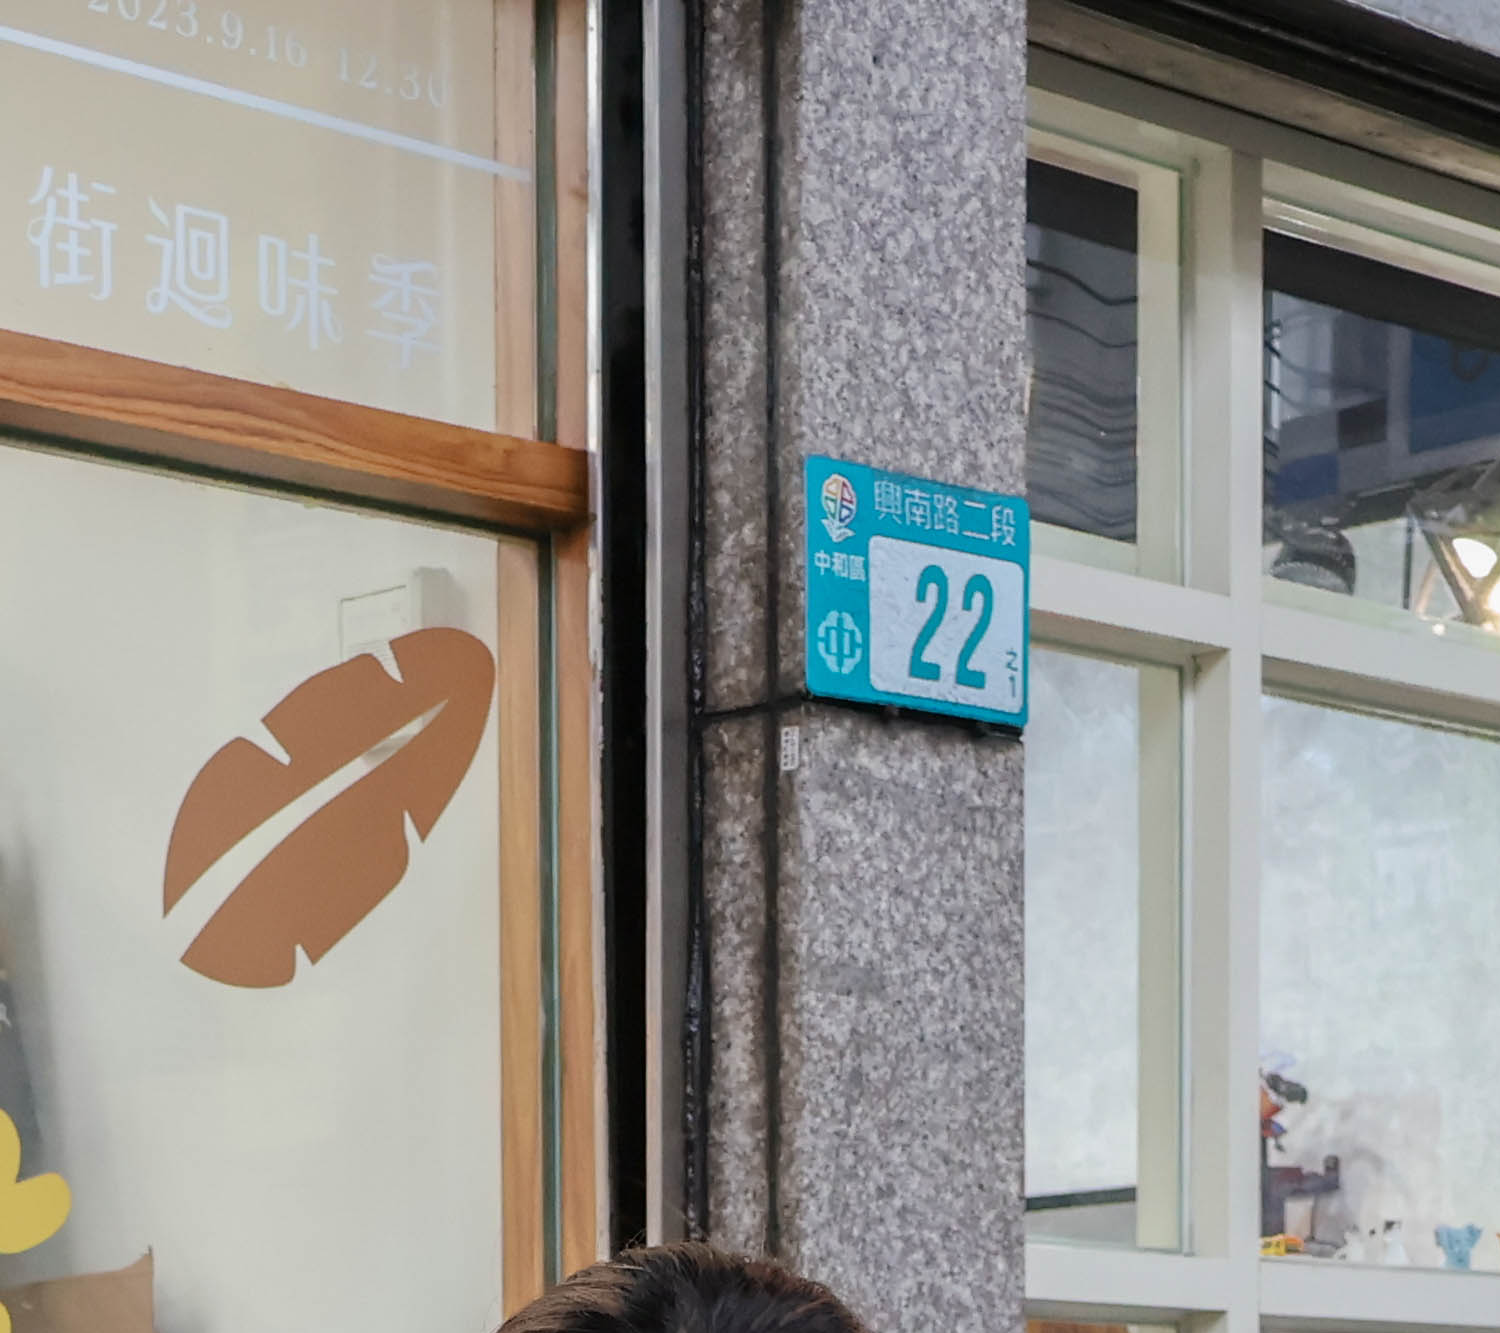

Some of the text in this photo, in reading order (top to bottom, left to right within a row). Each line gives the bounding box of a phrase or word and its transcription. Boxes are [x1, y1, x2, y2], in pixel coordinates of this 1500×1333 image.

[873, 479, 1016, 546] 興南路二段
[813, 550, 866, 582] 中和區
[909, 564, 993, 689] 22
